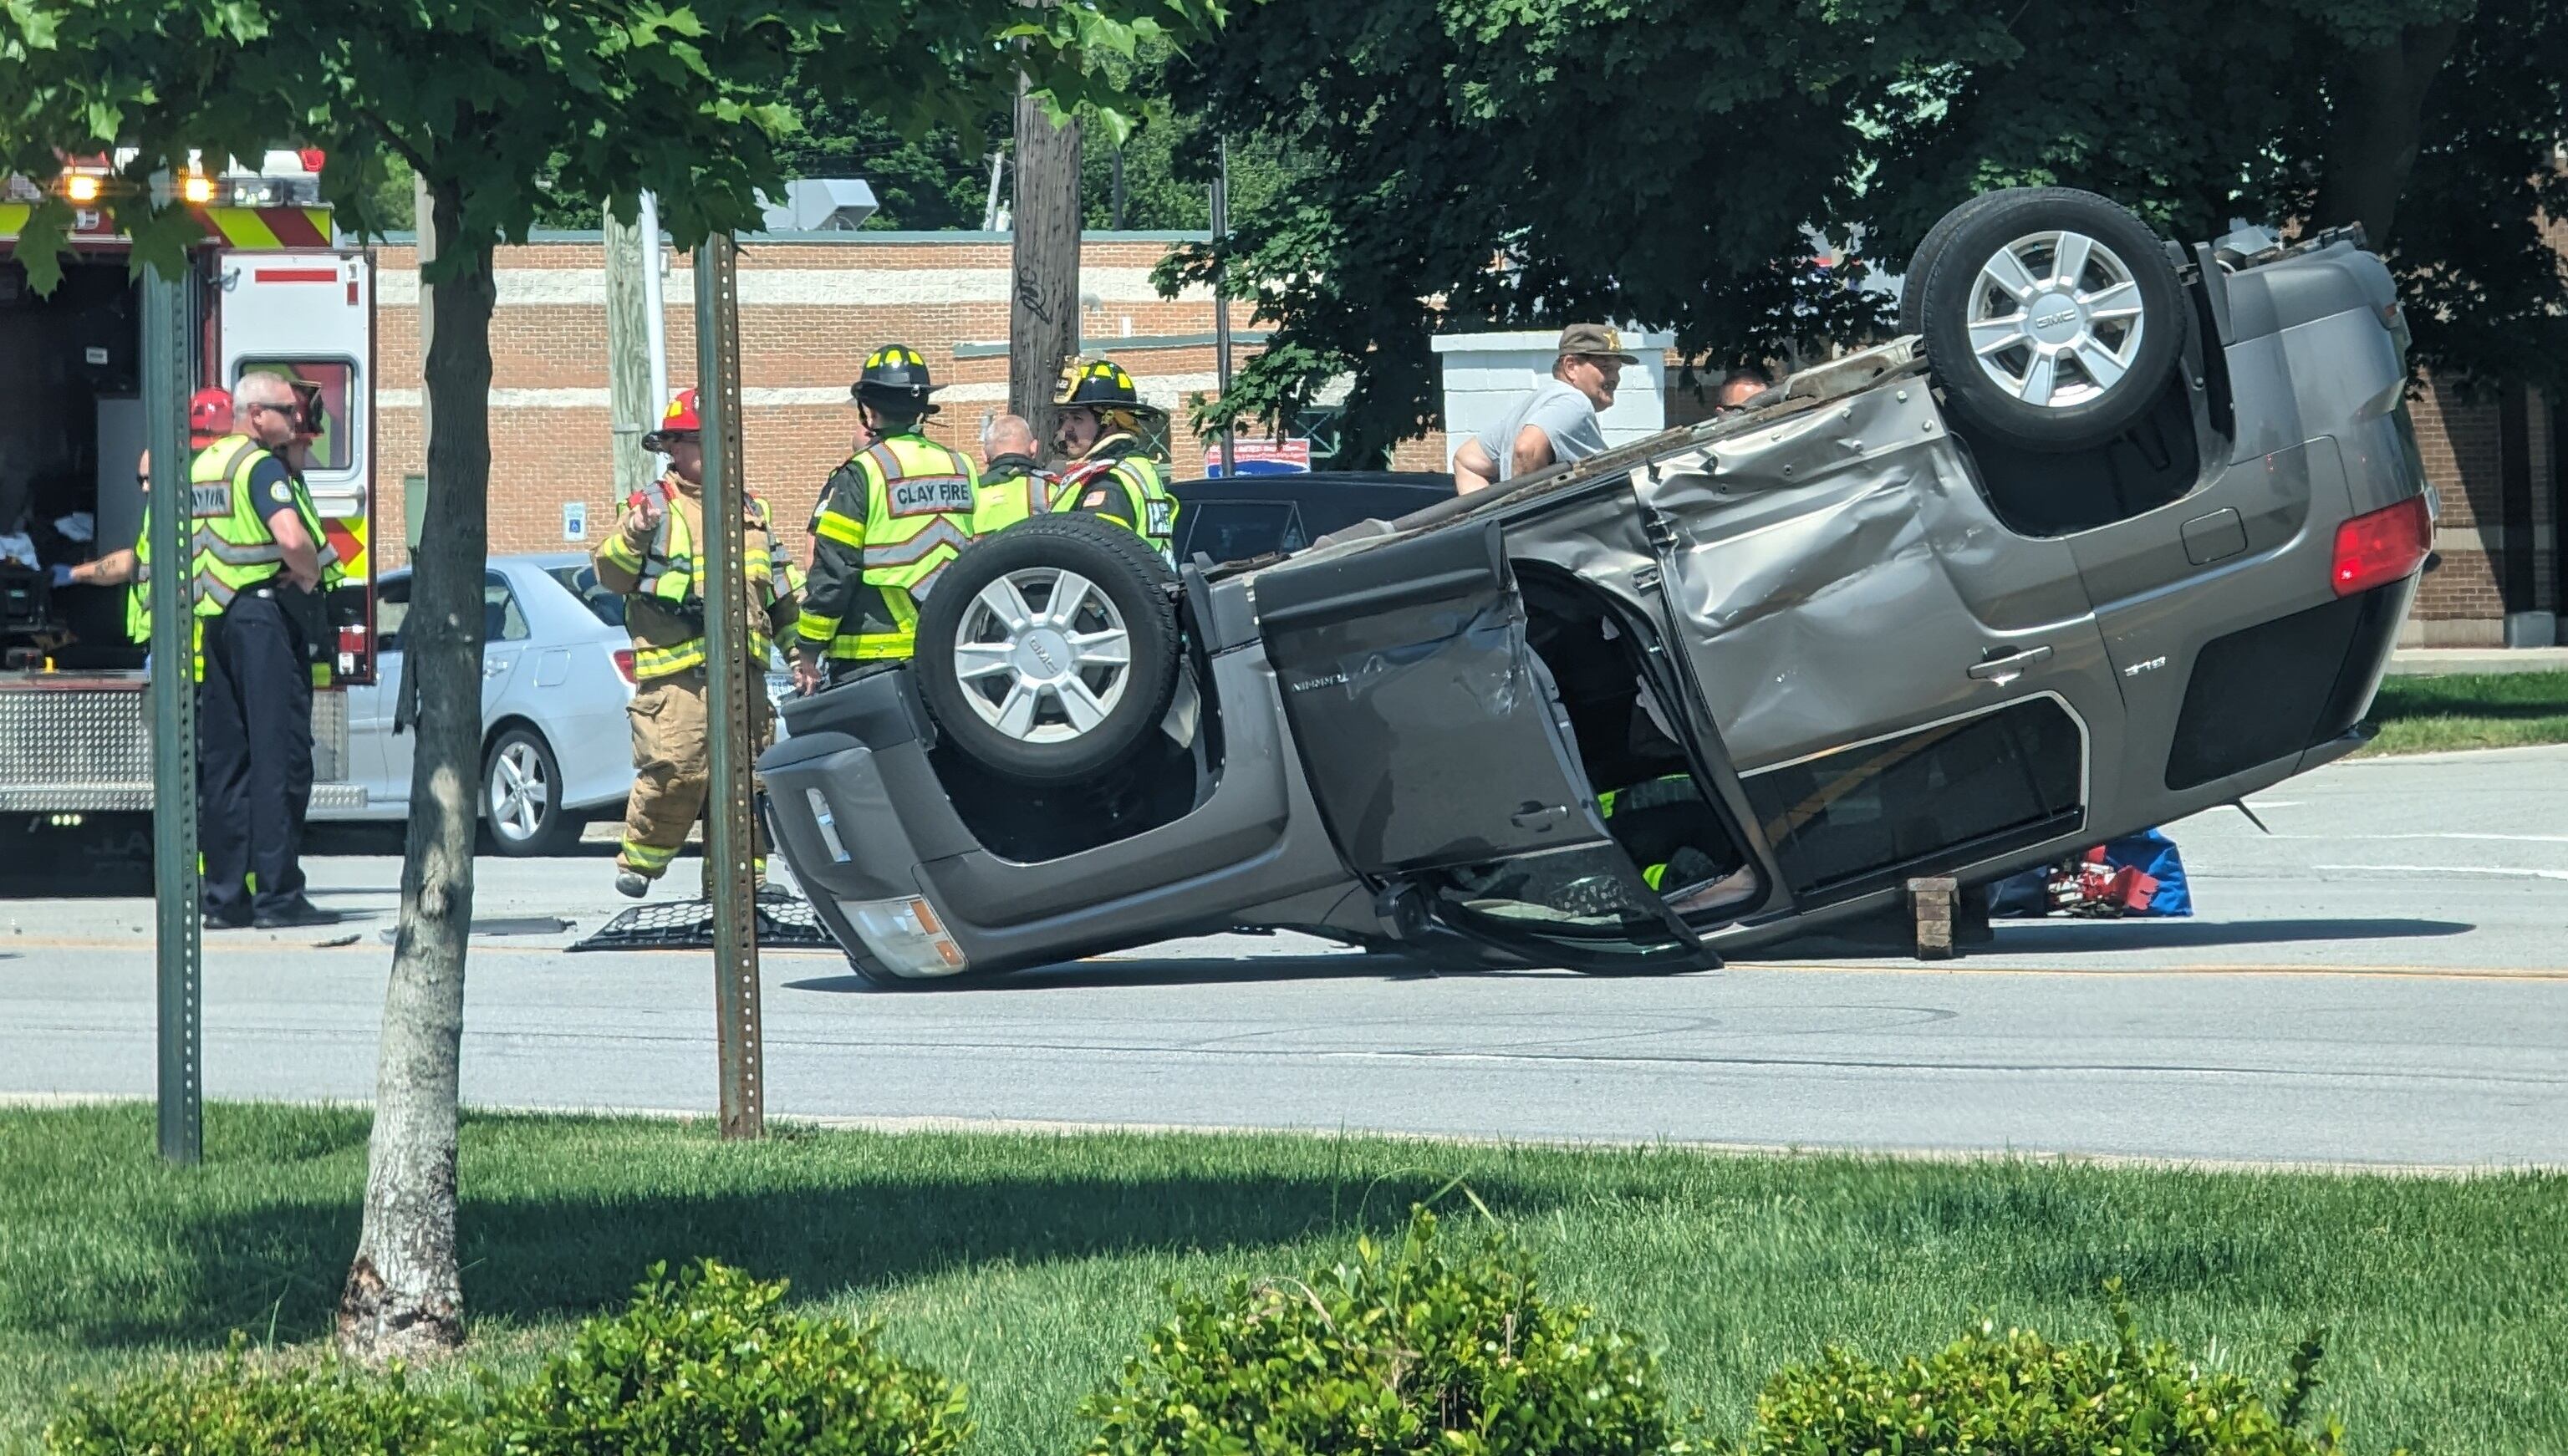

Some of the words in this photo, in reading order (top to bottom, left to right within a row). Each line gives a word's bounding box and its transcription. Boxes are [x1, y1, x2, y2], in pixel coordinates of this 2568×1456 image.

[2036, 308, 2076, 328] GMC
[897, 485, 935, 505] CLAY
[939, 483, 969, 501] FIRE
